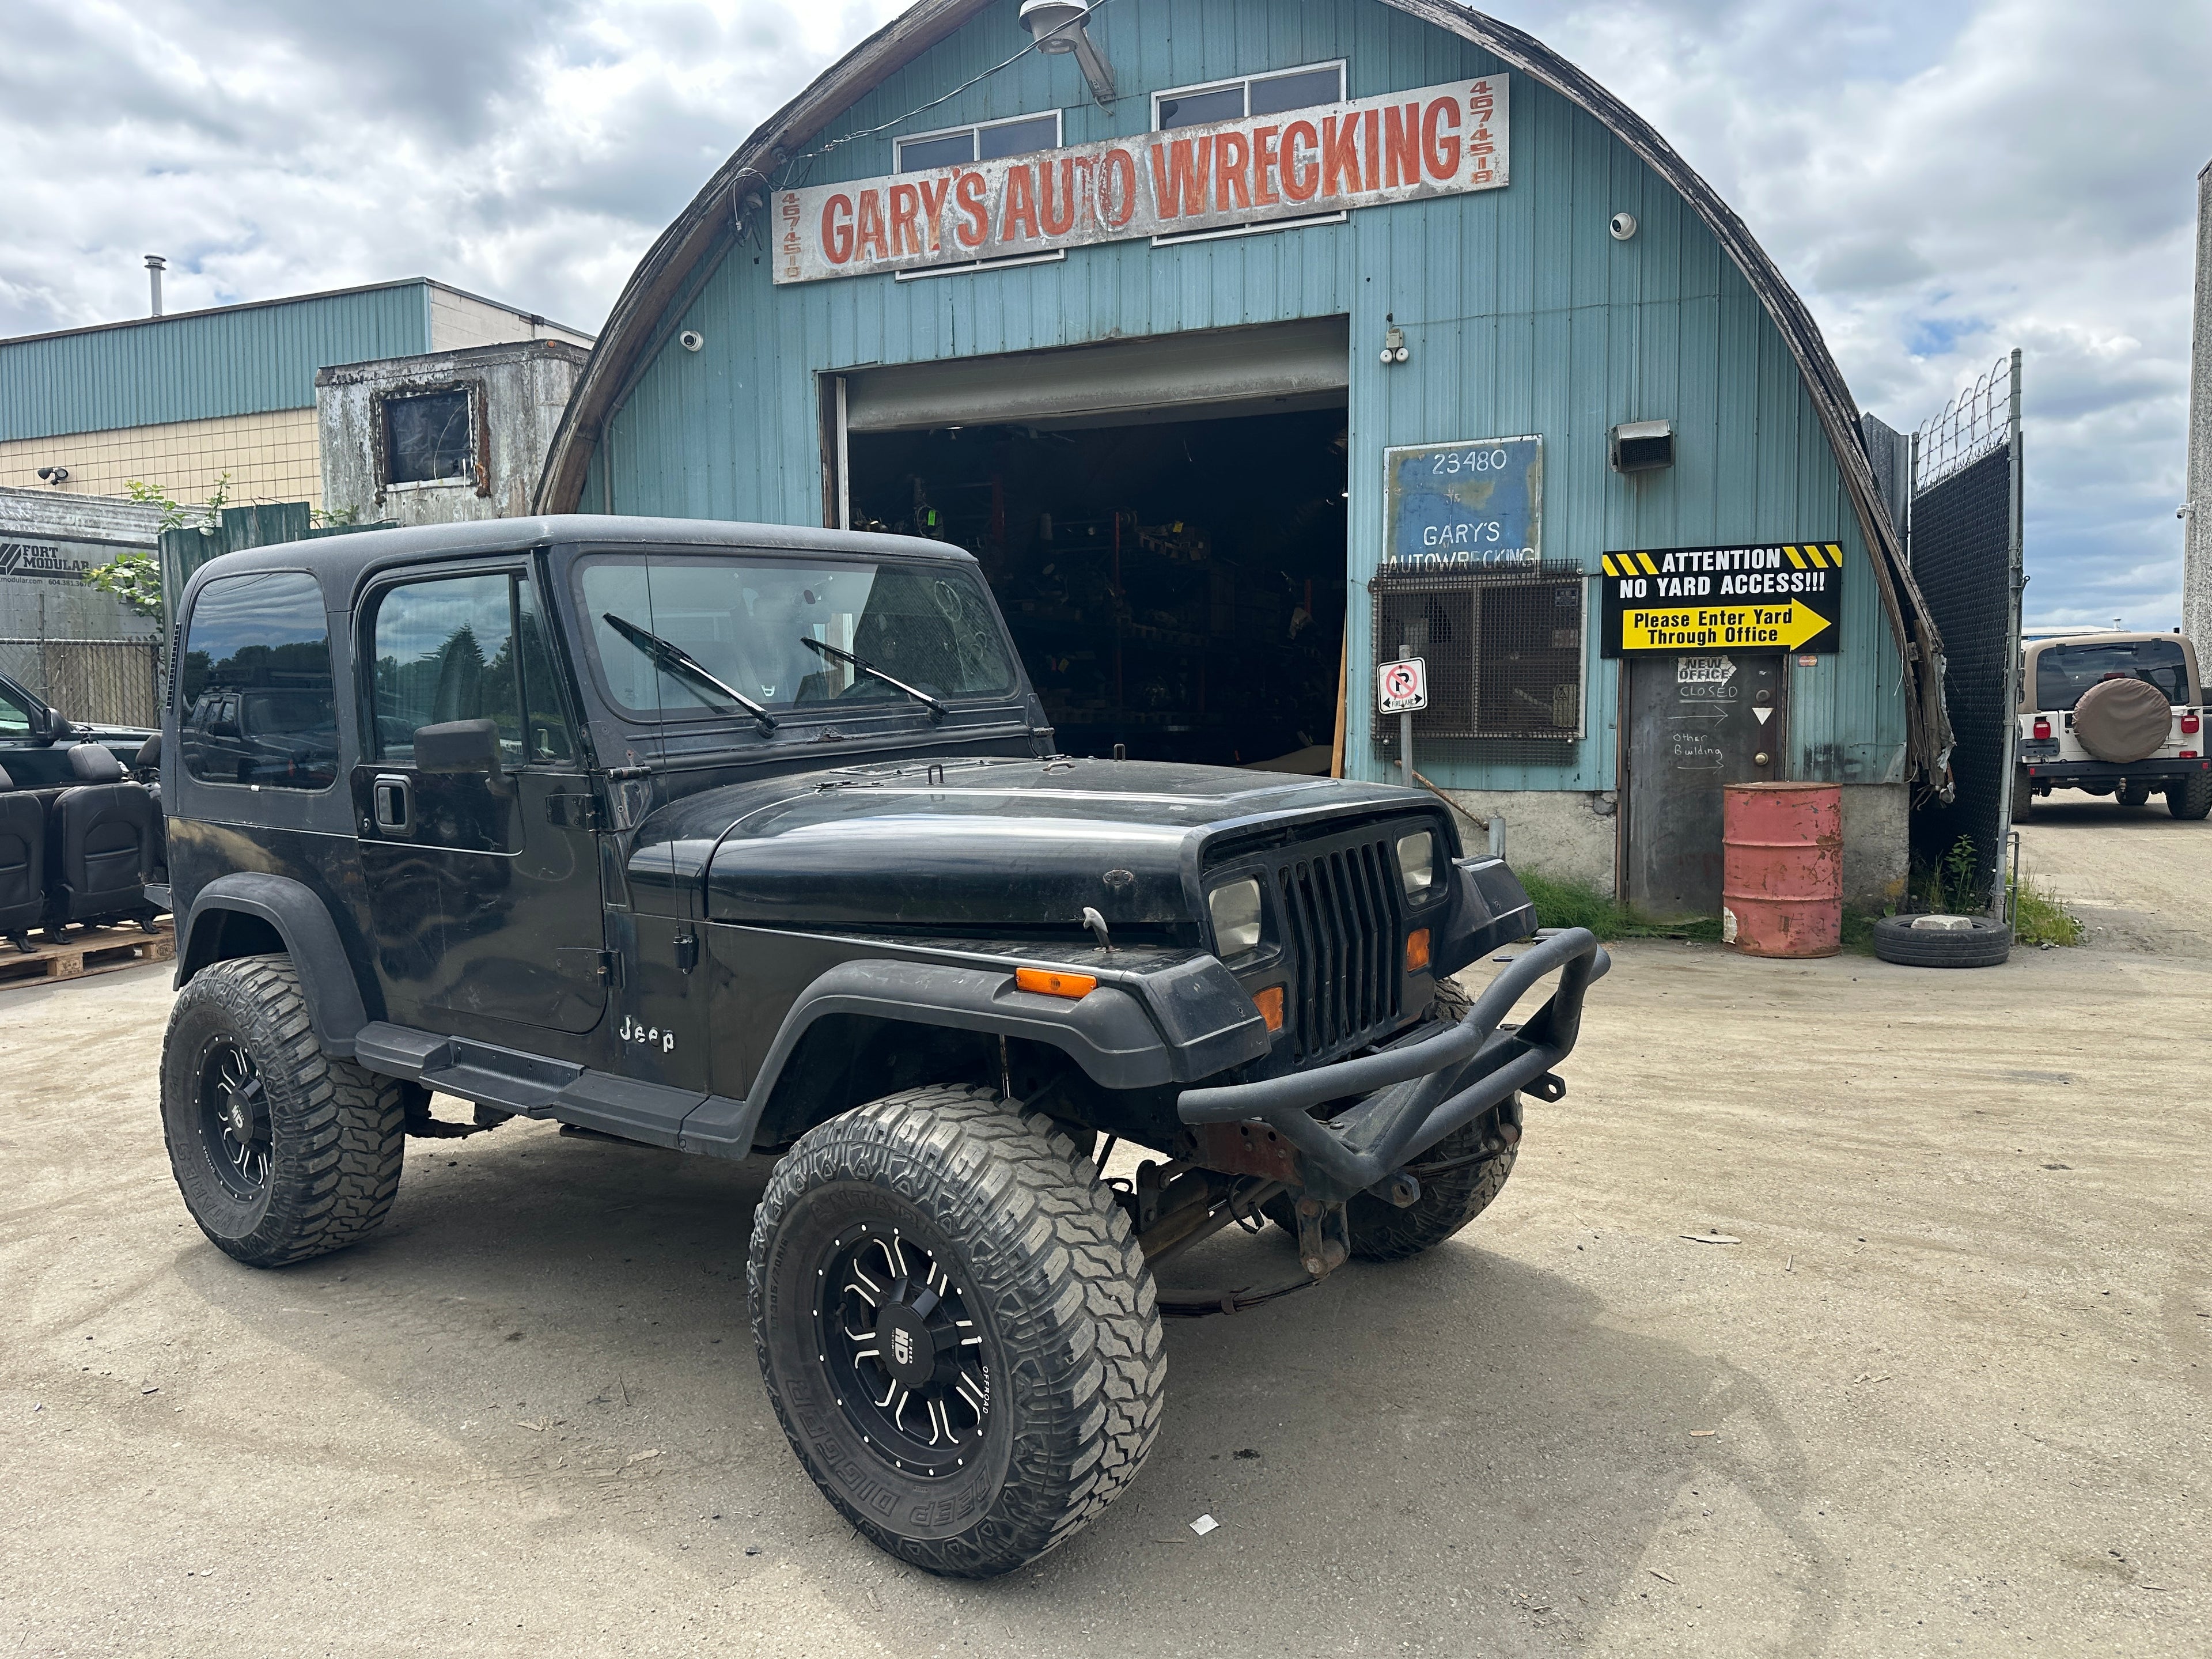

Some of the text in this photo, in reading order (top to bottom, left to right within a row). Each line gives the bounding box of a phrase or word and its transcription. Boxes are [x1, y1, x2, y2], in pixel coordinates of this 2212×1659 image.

[821, 96, 1461, 264] GARY'S AUTO WRECKING
[1432, 449, 1507, 475] 23480
[1423, 521, 1500, 546] GARY'S
[22, 544, 59, 558] FORT
[1661, 548, 1781, 573] ATTENTION
[23, 556, 90, 571] MODULAR
[0, 577, 43, 585] modular.com
[1620, 572, 1825, 599] NO YARD ACCESS!!!
[1634, 608, 1793, 628] Please Enter Yard
[1647, 627, 1778, 646] Through Office
[1687, 658, 1722, 669] NEW
[1679, 670, 1730, 680] OFFICE
[1680, 685, 1737, 698] CLOSED
[619, 1016, 674, 1054] Jeep
[895, 1327, 909, 1365] HD
[786, 1380, 991, 1527] DEEP DIGGER
